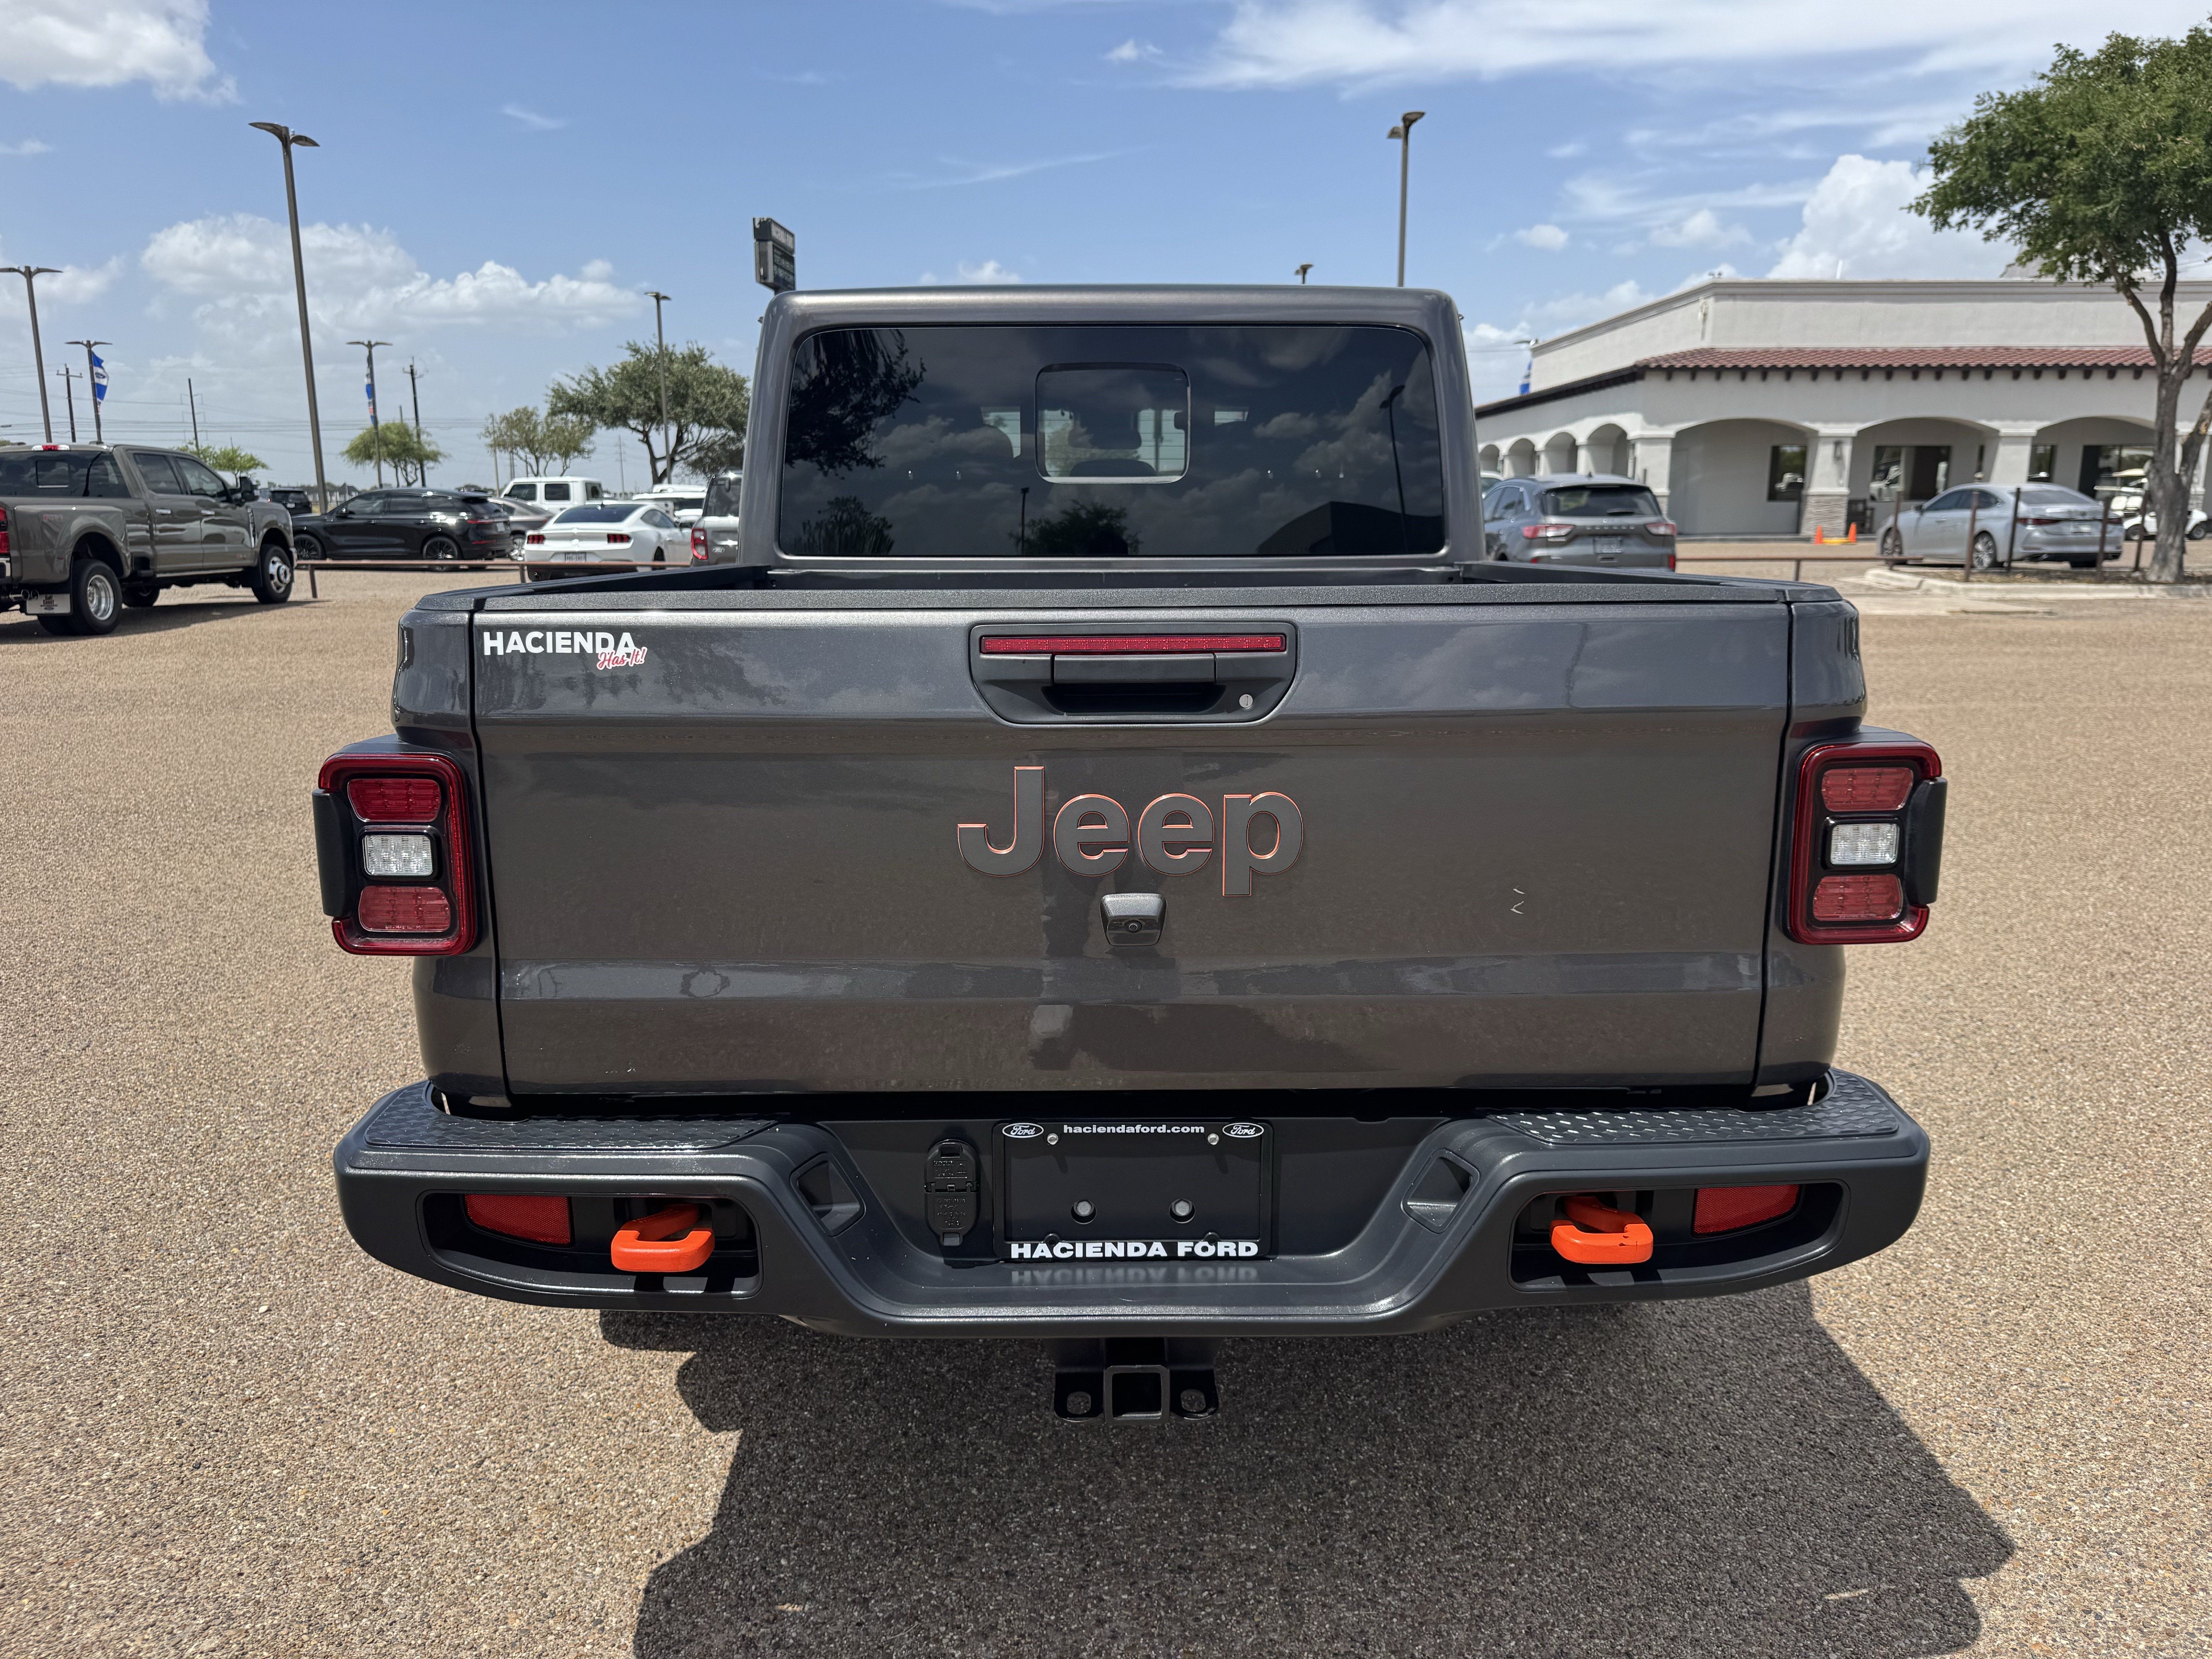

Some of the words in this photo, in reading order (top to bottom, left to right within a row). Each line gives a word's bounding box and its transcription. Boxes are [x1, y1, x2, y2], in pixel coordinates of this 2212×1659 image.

[483, 632, 637, 655] HACIENDA
[598, 651, 628, 668] Has
[630, 648, 646, 665] It!
[958, 766, 1304, 896] Jeep
[1063, 1124, 1205, 1133] haciendaford.com
[1011, 1242, 1168, 1258] HACIENDA
[1177, 1242, 1259, 1257] FORD
